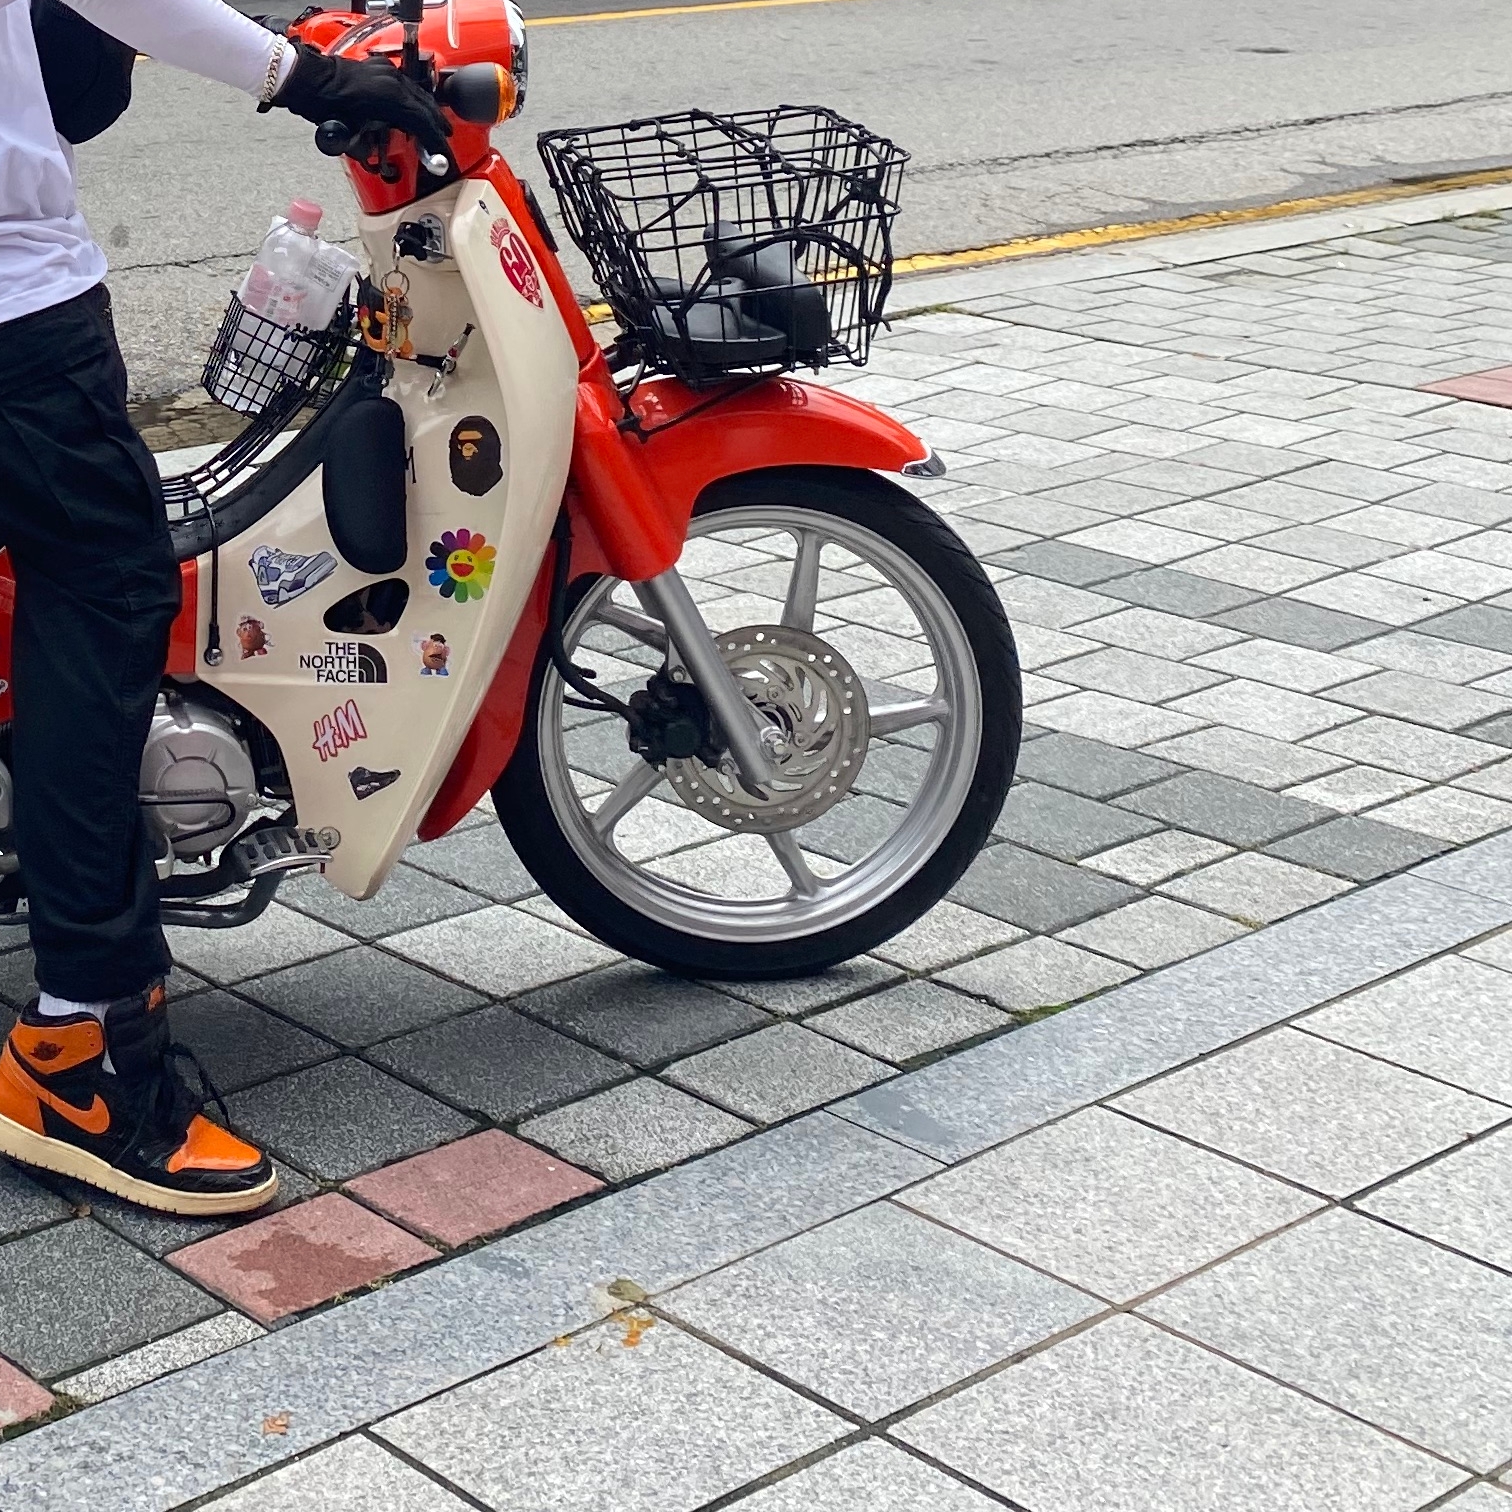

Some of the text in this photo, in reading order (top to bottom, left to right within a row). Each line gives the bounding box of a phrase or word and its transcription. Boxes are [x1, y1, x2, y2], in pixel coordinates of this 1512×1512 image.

[325, 642, 358, 656] THE
[299, 655, 359, 669] NORTH
[316, 669, 358, 683] FACE
